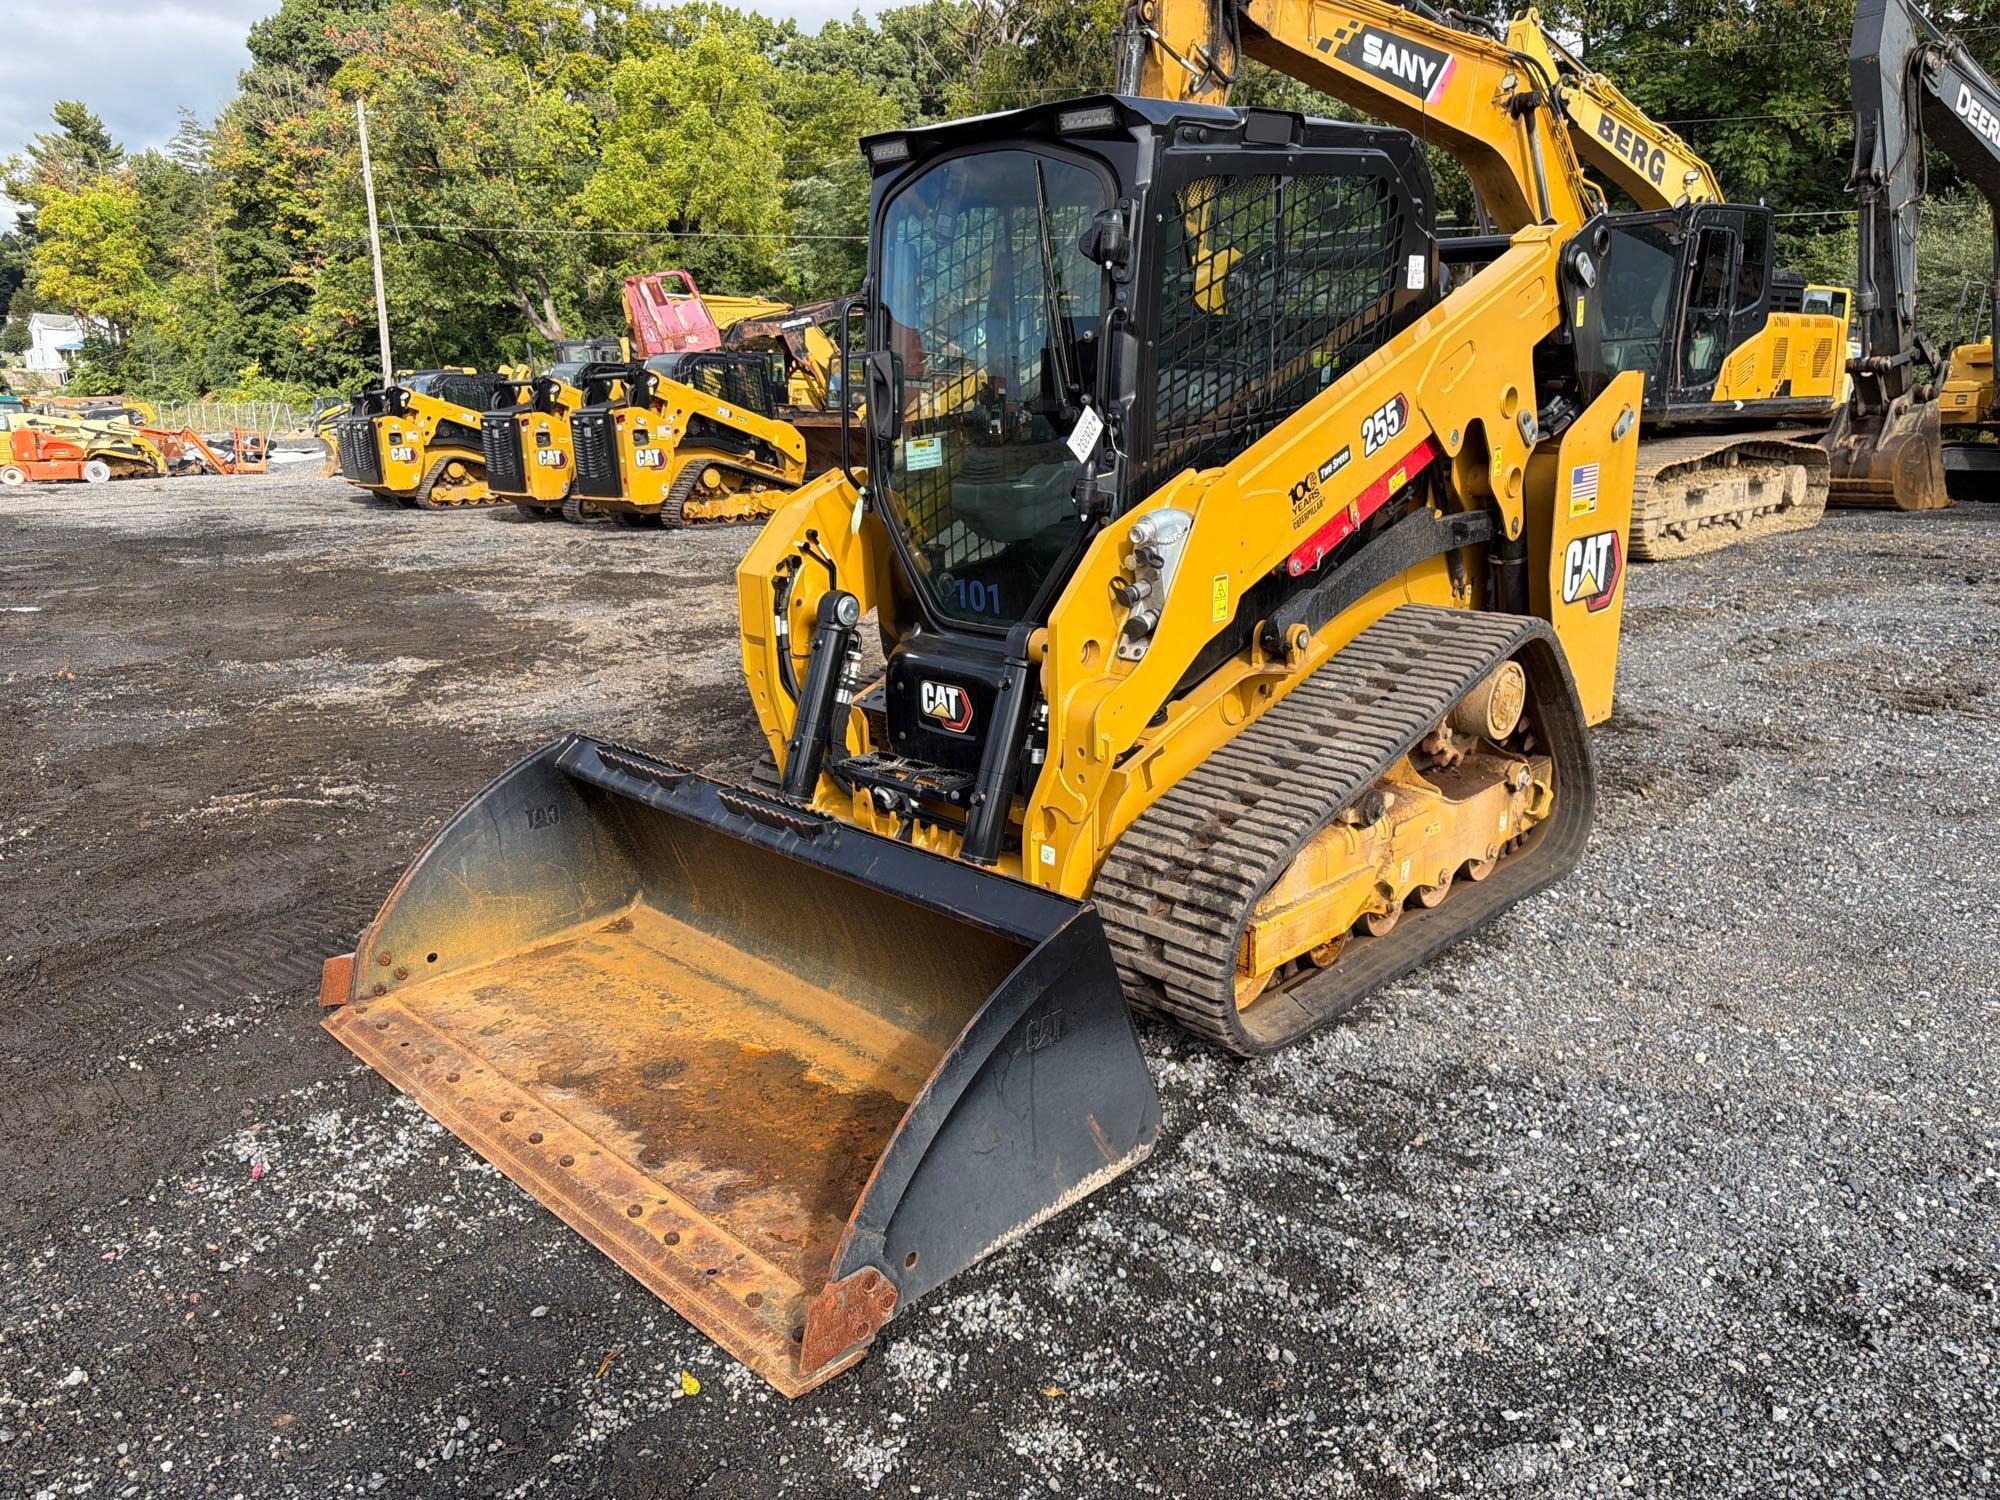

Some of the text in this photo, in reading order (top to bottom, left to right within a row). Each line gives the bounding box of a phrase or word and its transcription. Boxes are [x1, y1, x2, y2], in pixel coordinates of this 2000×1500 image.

[1363, 33, 1437, 89] SANY
[1597, 114, 1667, 187] BERG
[1362, 398, 1400, 456] 255
[391, 447, 412, 461] CAT
[538, 450, 561, 466] CAT
[635, 449, 660, 467] CAT
[1292, 488, 1321, 516] YEARS
[1563, 532, 1613, 603] CAT
[954, 578, 1000, 615] 101
[921, 682, 959, 720] CAT
